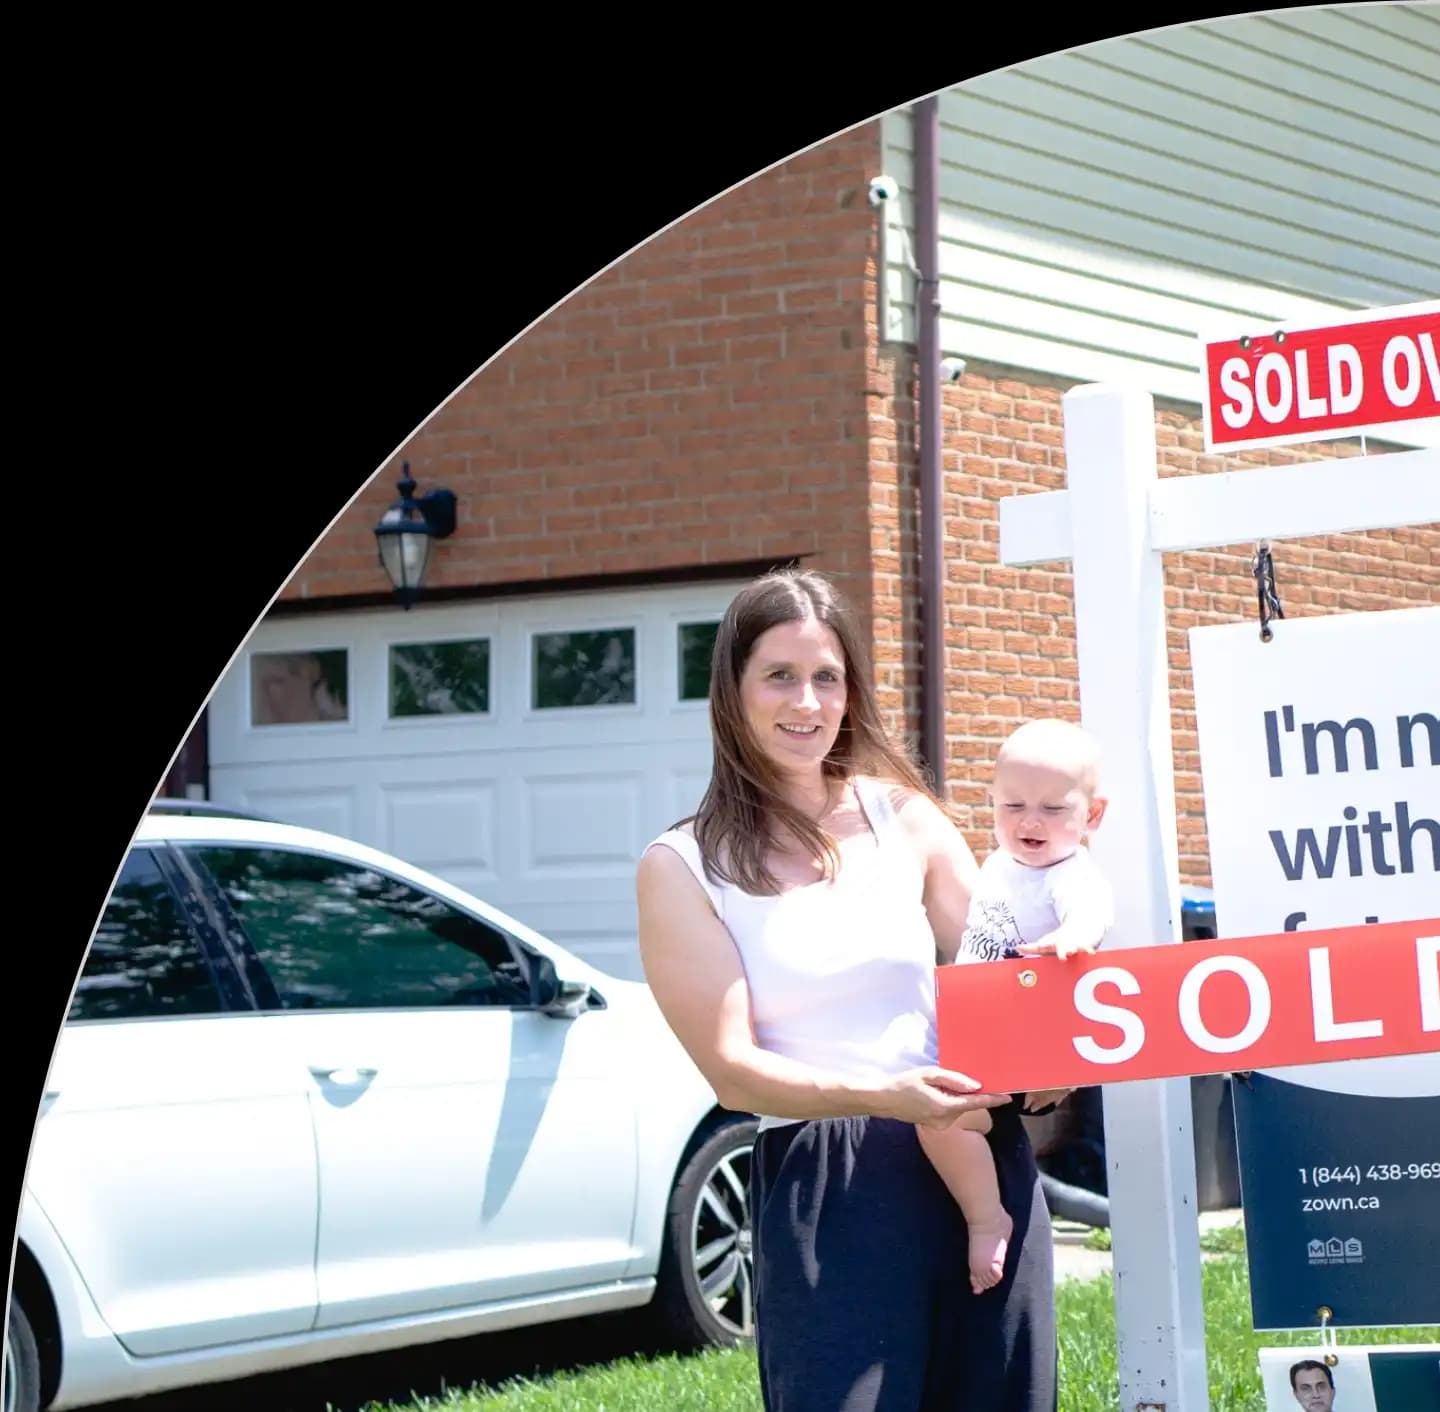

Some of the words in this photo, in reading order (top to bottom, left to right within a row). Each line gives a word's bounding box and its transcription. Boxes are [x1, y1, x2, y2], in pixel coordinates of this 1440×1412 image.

[1219, 343, 1364, 430] SOLD
[1264, 704, 1379, 778] I'm
[1298, 1167, 1308, 1185] 1
[1312, 1165, 1361, 1188] (844)
[1302, 1195, 1380, 1212] zown.ca
